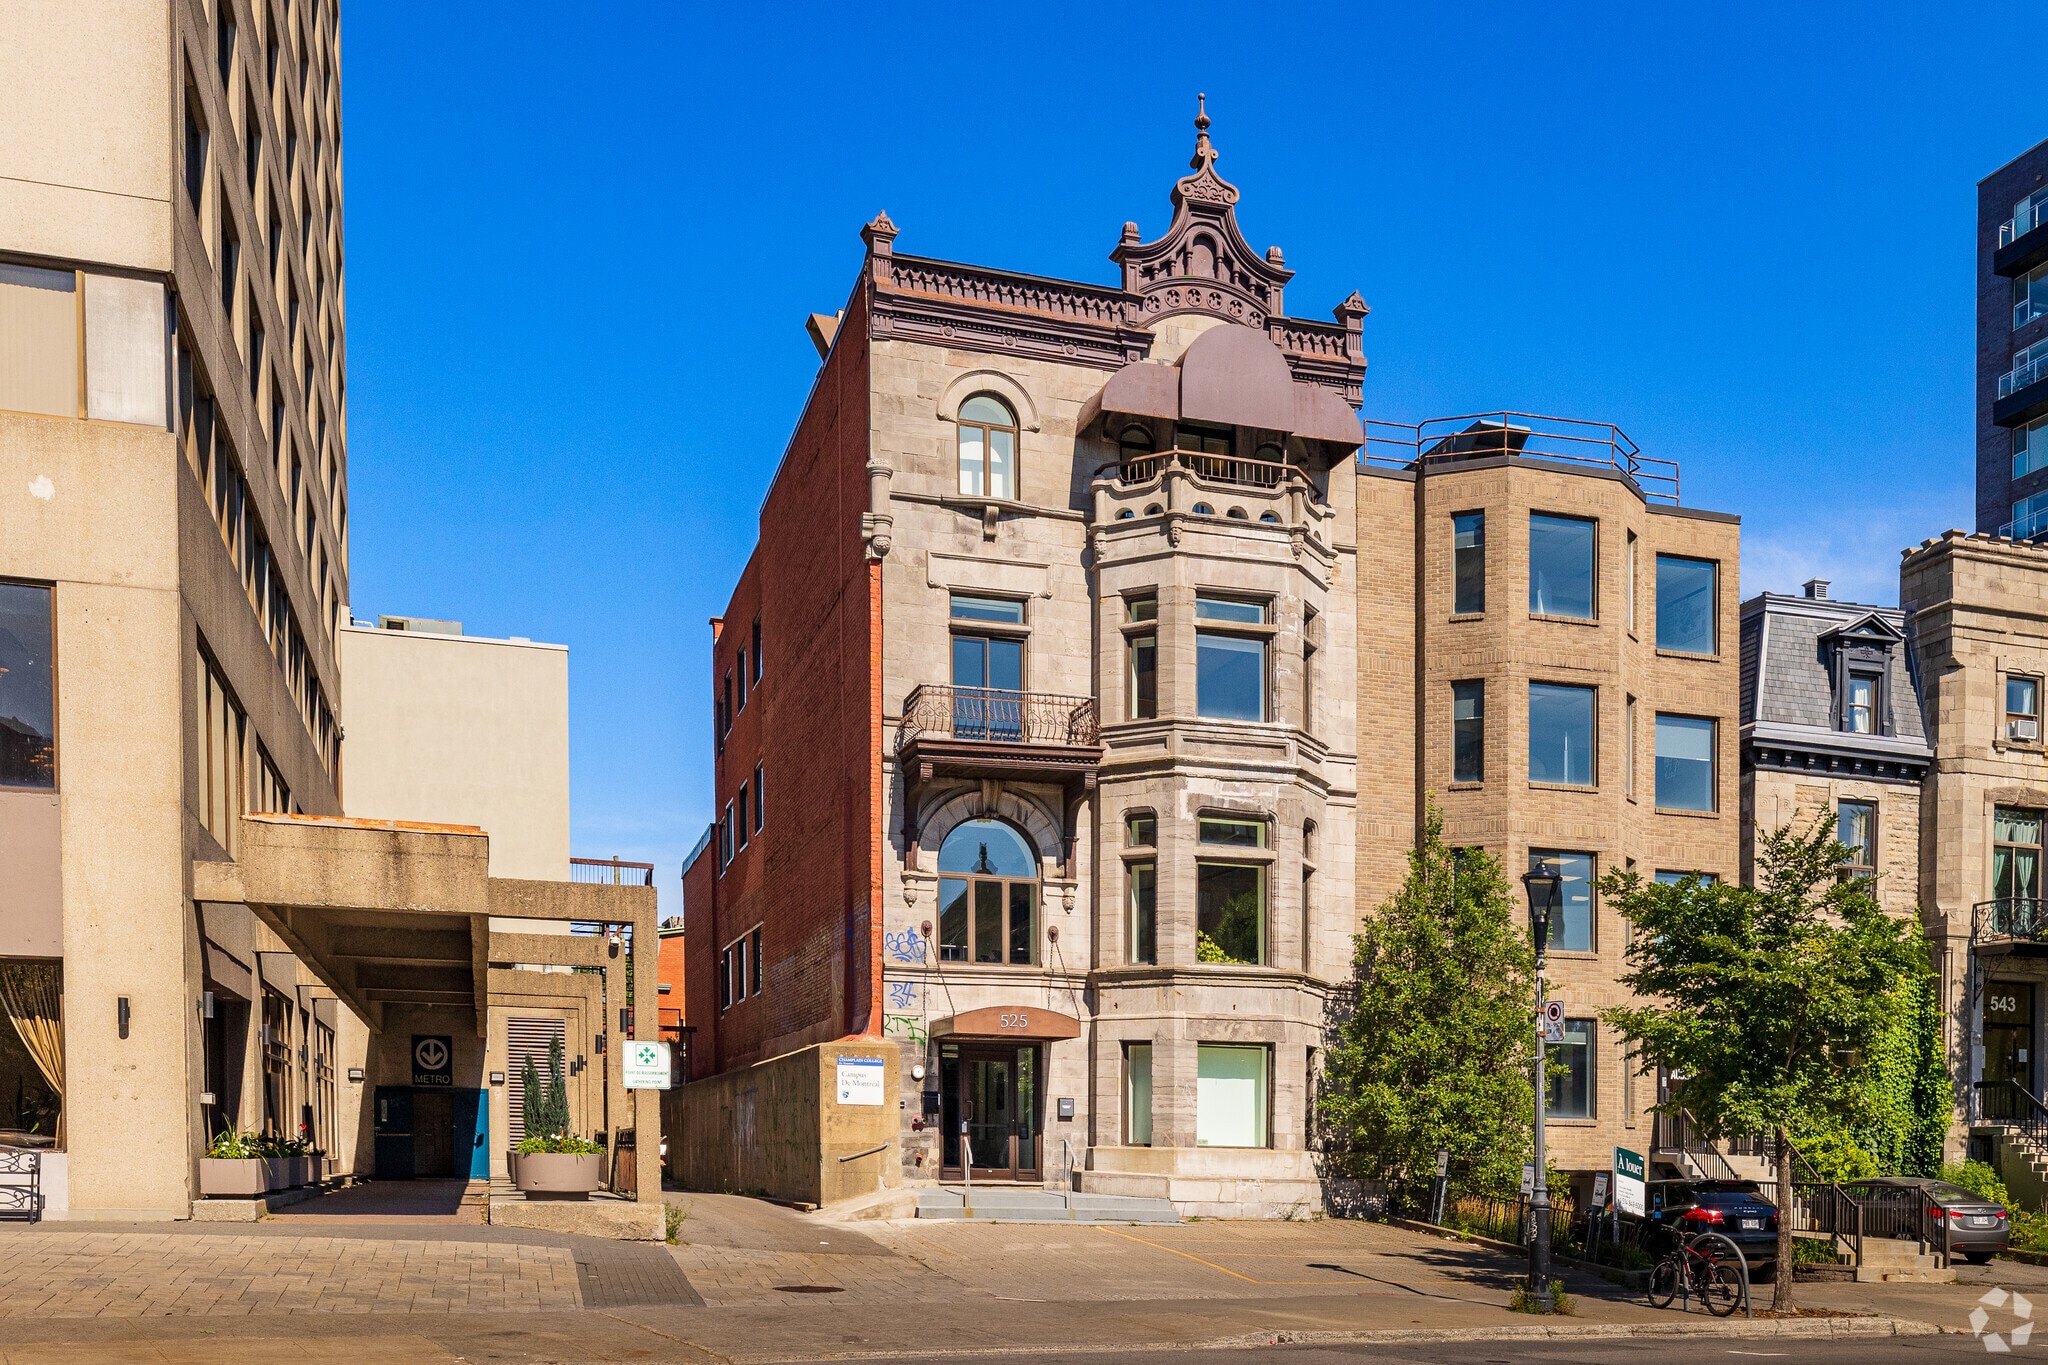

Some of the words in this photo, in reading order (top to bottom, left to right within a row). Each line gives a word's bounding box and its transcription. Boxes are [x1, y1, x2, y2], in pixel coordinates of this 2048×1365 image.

[1990, 996, 2016, 1012] 543
[1000, 1014, 1028, 1028] 525
[414, 1074, 450, 1084] METRO
[841, 1071, 867, 1079] Campus
[852, 1079, 880, 1087] Montréal
[1618, 1153, 1625, 1170] À
[1625, 1157, 1643, 1176] louer
